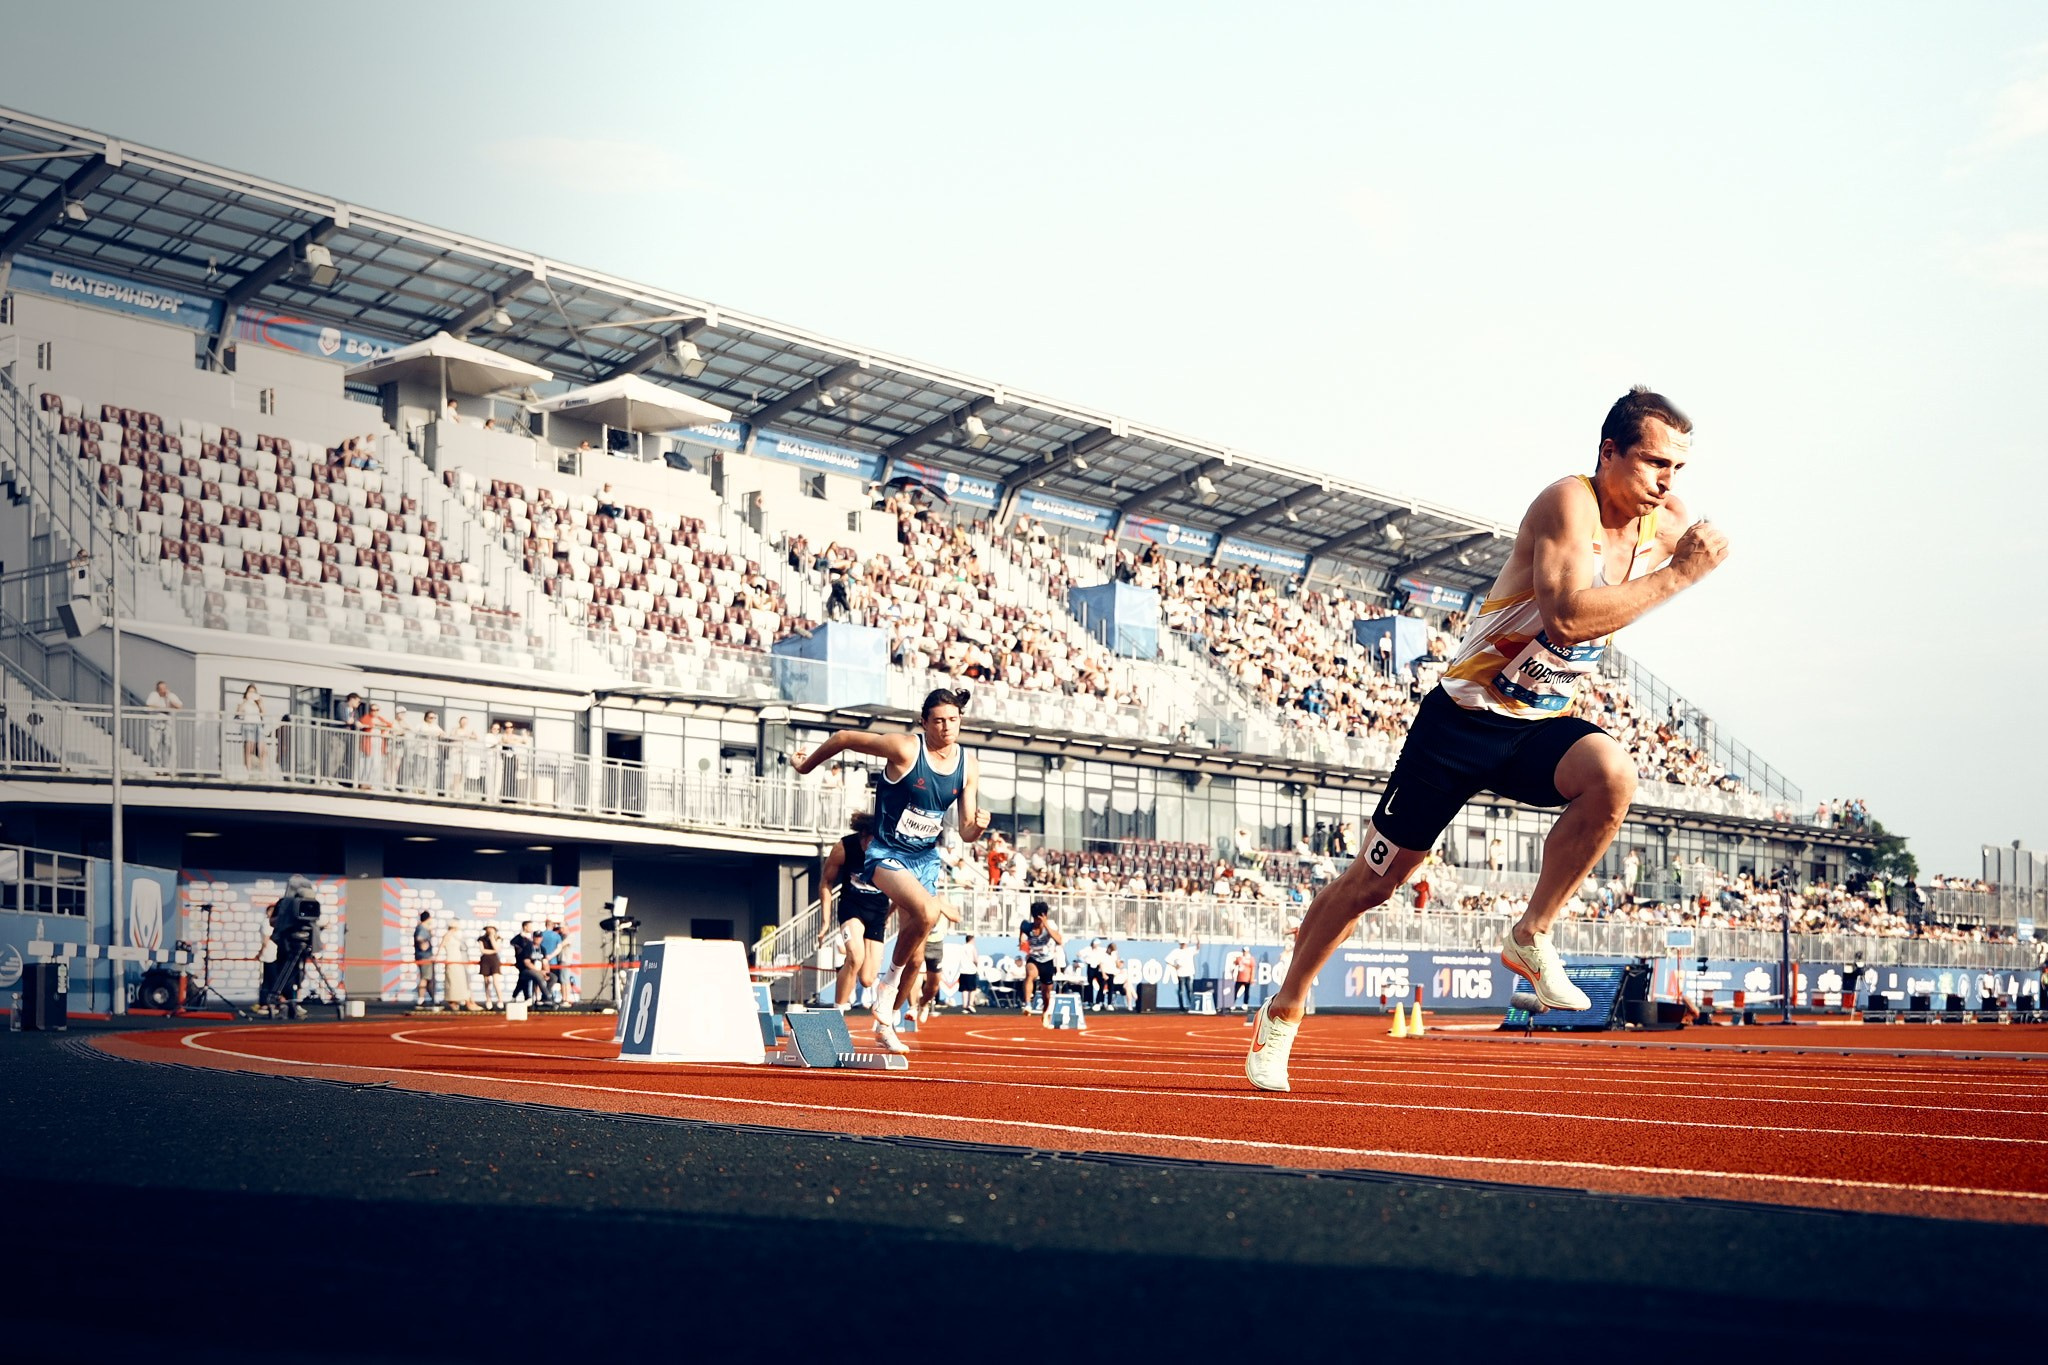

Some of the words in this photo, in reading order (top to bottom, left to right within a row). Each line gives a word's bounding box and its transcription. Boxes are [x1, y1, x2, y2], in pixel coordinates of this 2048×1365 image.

[50, 270, 184, 314] ЕКАТЕРИНБУРГ
[345, 338, 394, 359] ВФЛ
[776, 440, 861, 469] EKATERINBURG
[1370, 840, 1389, 866] 8
[1127, 957, 1179, 986] ВФЛ
[1452, 969, 1493, 999] ПСБ
[633, 982, 653, 1045] 8
